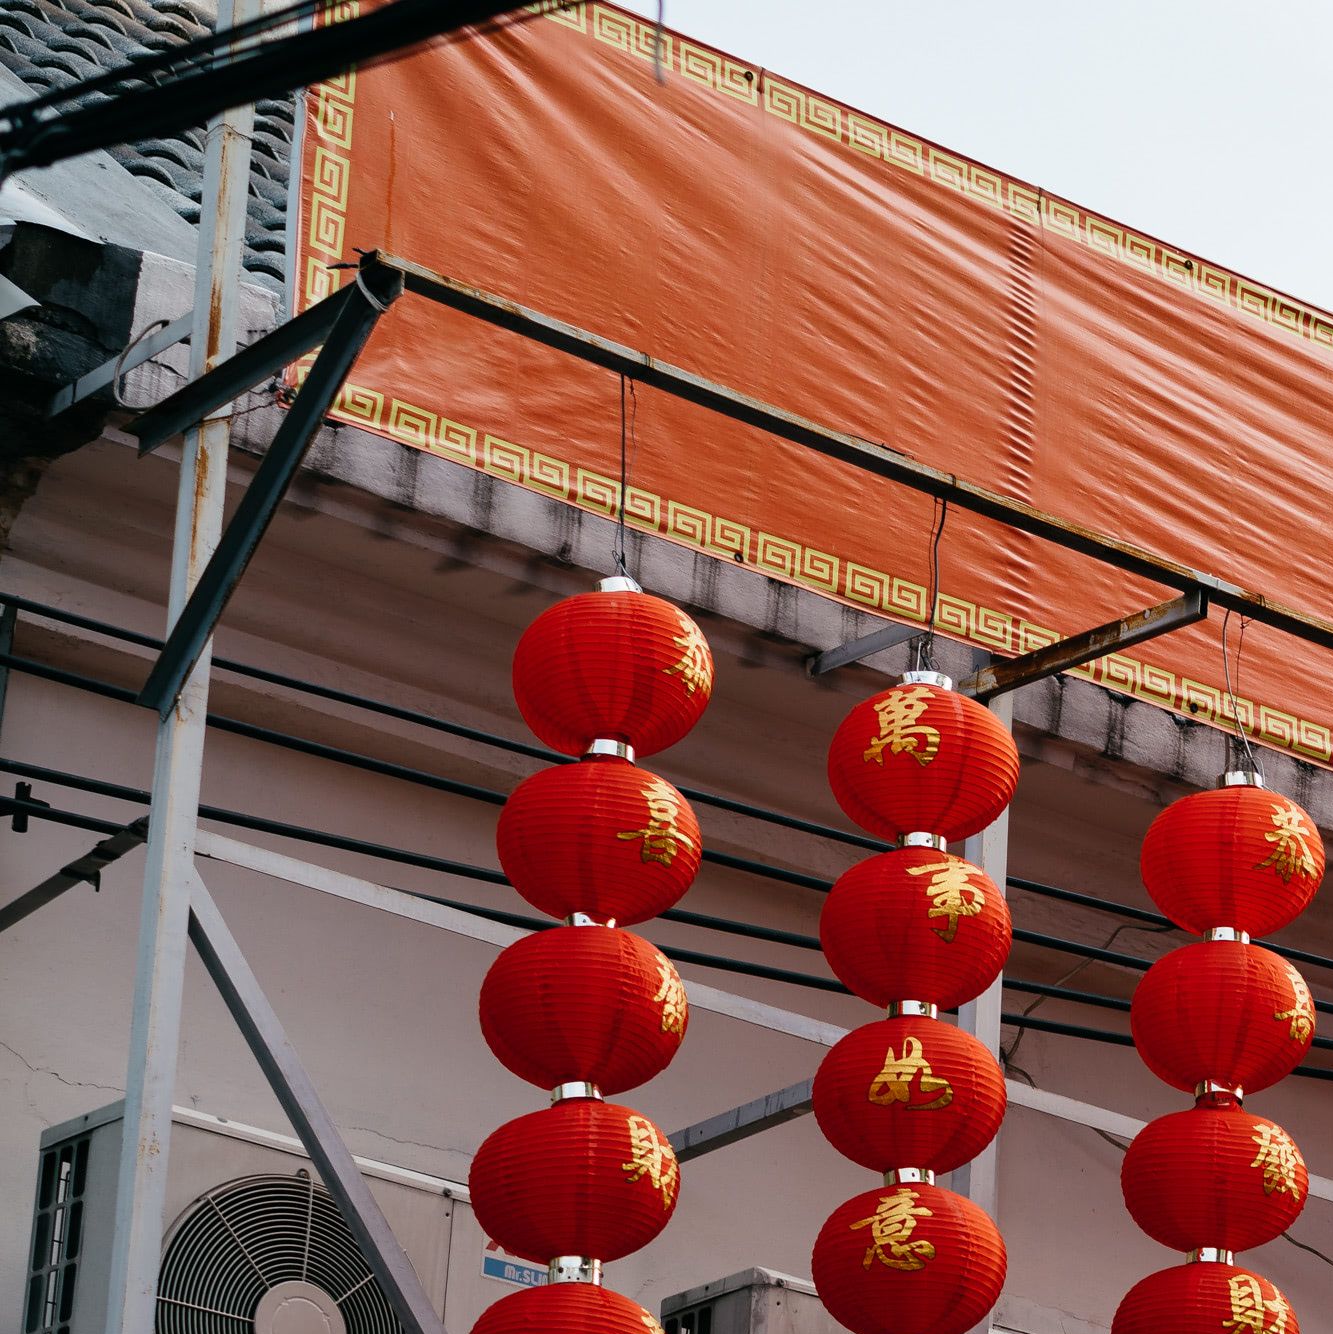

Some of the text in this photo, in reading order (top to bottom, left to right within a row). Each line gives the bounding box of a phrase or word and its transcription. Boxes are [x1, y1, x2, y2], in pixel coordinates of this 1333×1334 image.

[863, 685, 943, 768] 萬
[617, 776, 697, 868] 喜
[1253, 799, 1320, 885] 恭
[905, 854, 986, 945] 事
[1273, 964, 1315, 1046] 喜
[868, 1034, 955, 1112] 如
[621, 1114, 680, 1212] 財
[1250, 1122, 1307, 1203] 發
[849, 1187, 937, 1272] 意
